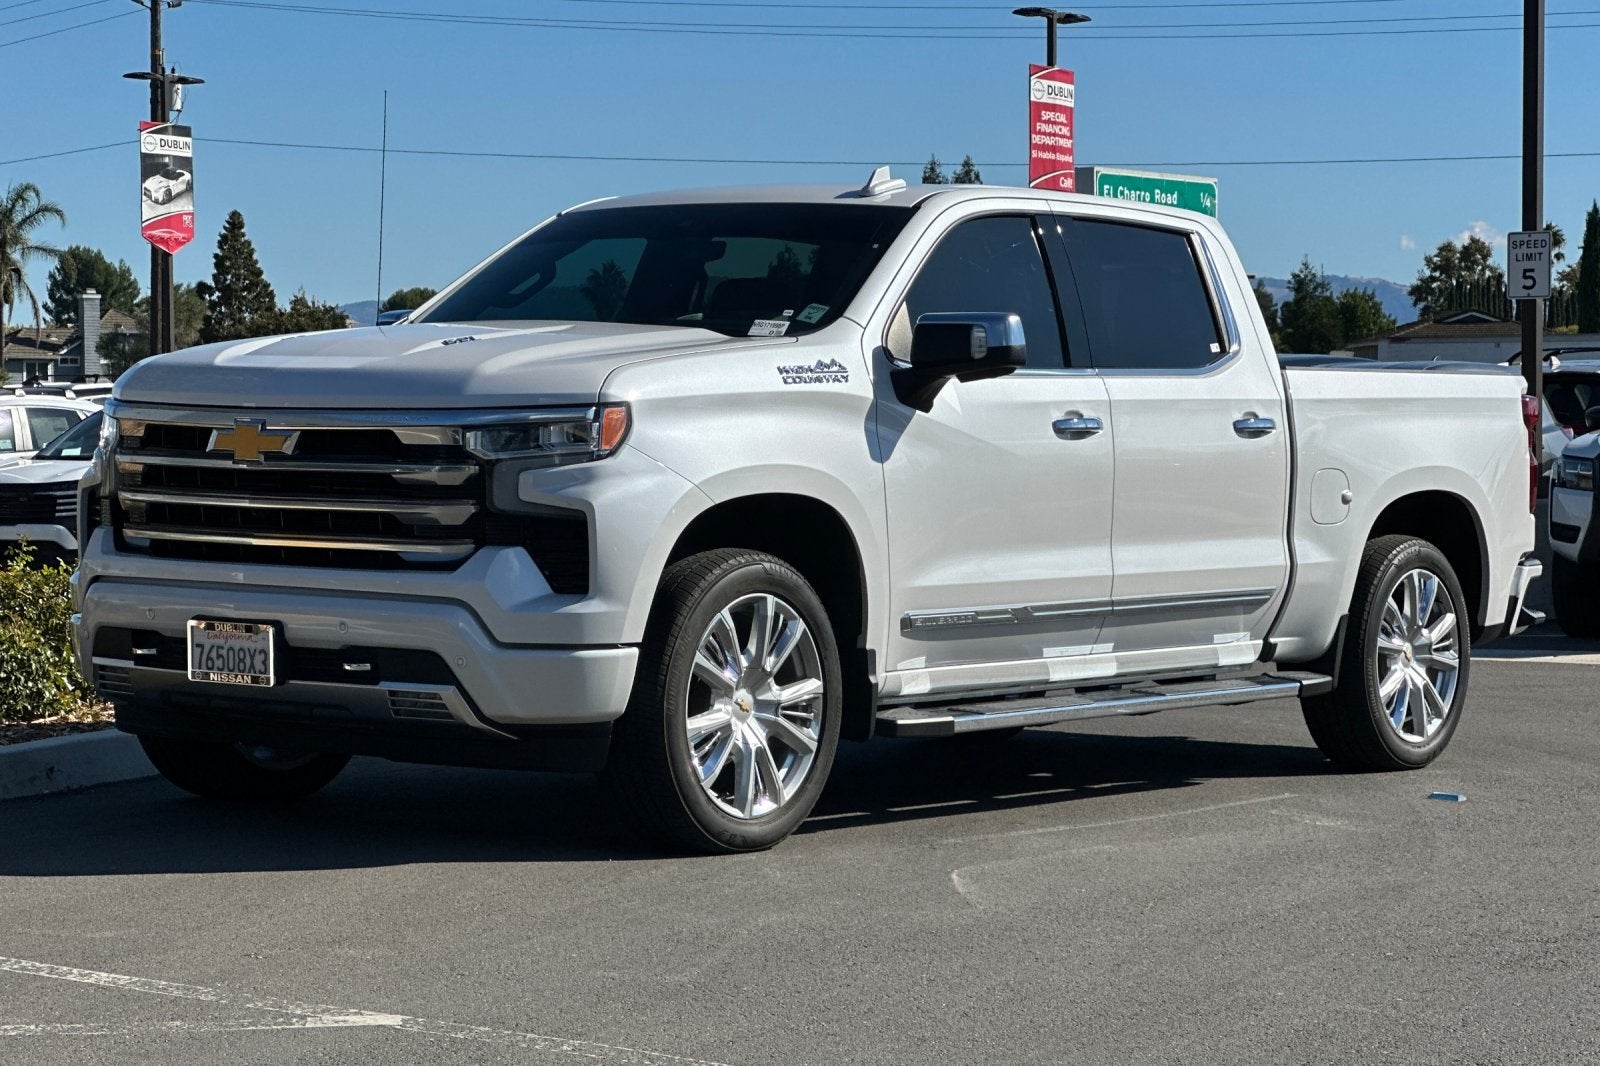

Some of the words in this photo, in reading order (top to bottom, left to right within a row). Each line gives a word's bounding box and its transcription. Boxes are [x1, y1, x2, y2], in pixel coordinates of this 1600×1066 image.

[1047, 84, 1073, 100] DUBLIN
[160, 138, 191, 150] DUBLIN
[1032, 133, 1073, 148] DEPARTMENT
[1103, 184, 1114, 198] El
[1117, 186, 1151, 202] Charro
[1154, 189, 1178, 205] Road
[1511, 239, 1547, 250] SPEED
[1515, 252, 1544, 262] LIMIT
[1521, 268, 1537, 291] 5
[782, 374, 849, 385] COUNTRY
[195, 643, 268, 675] 76508X3
[209, 672, 252, 684] NISSAN
